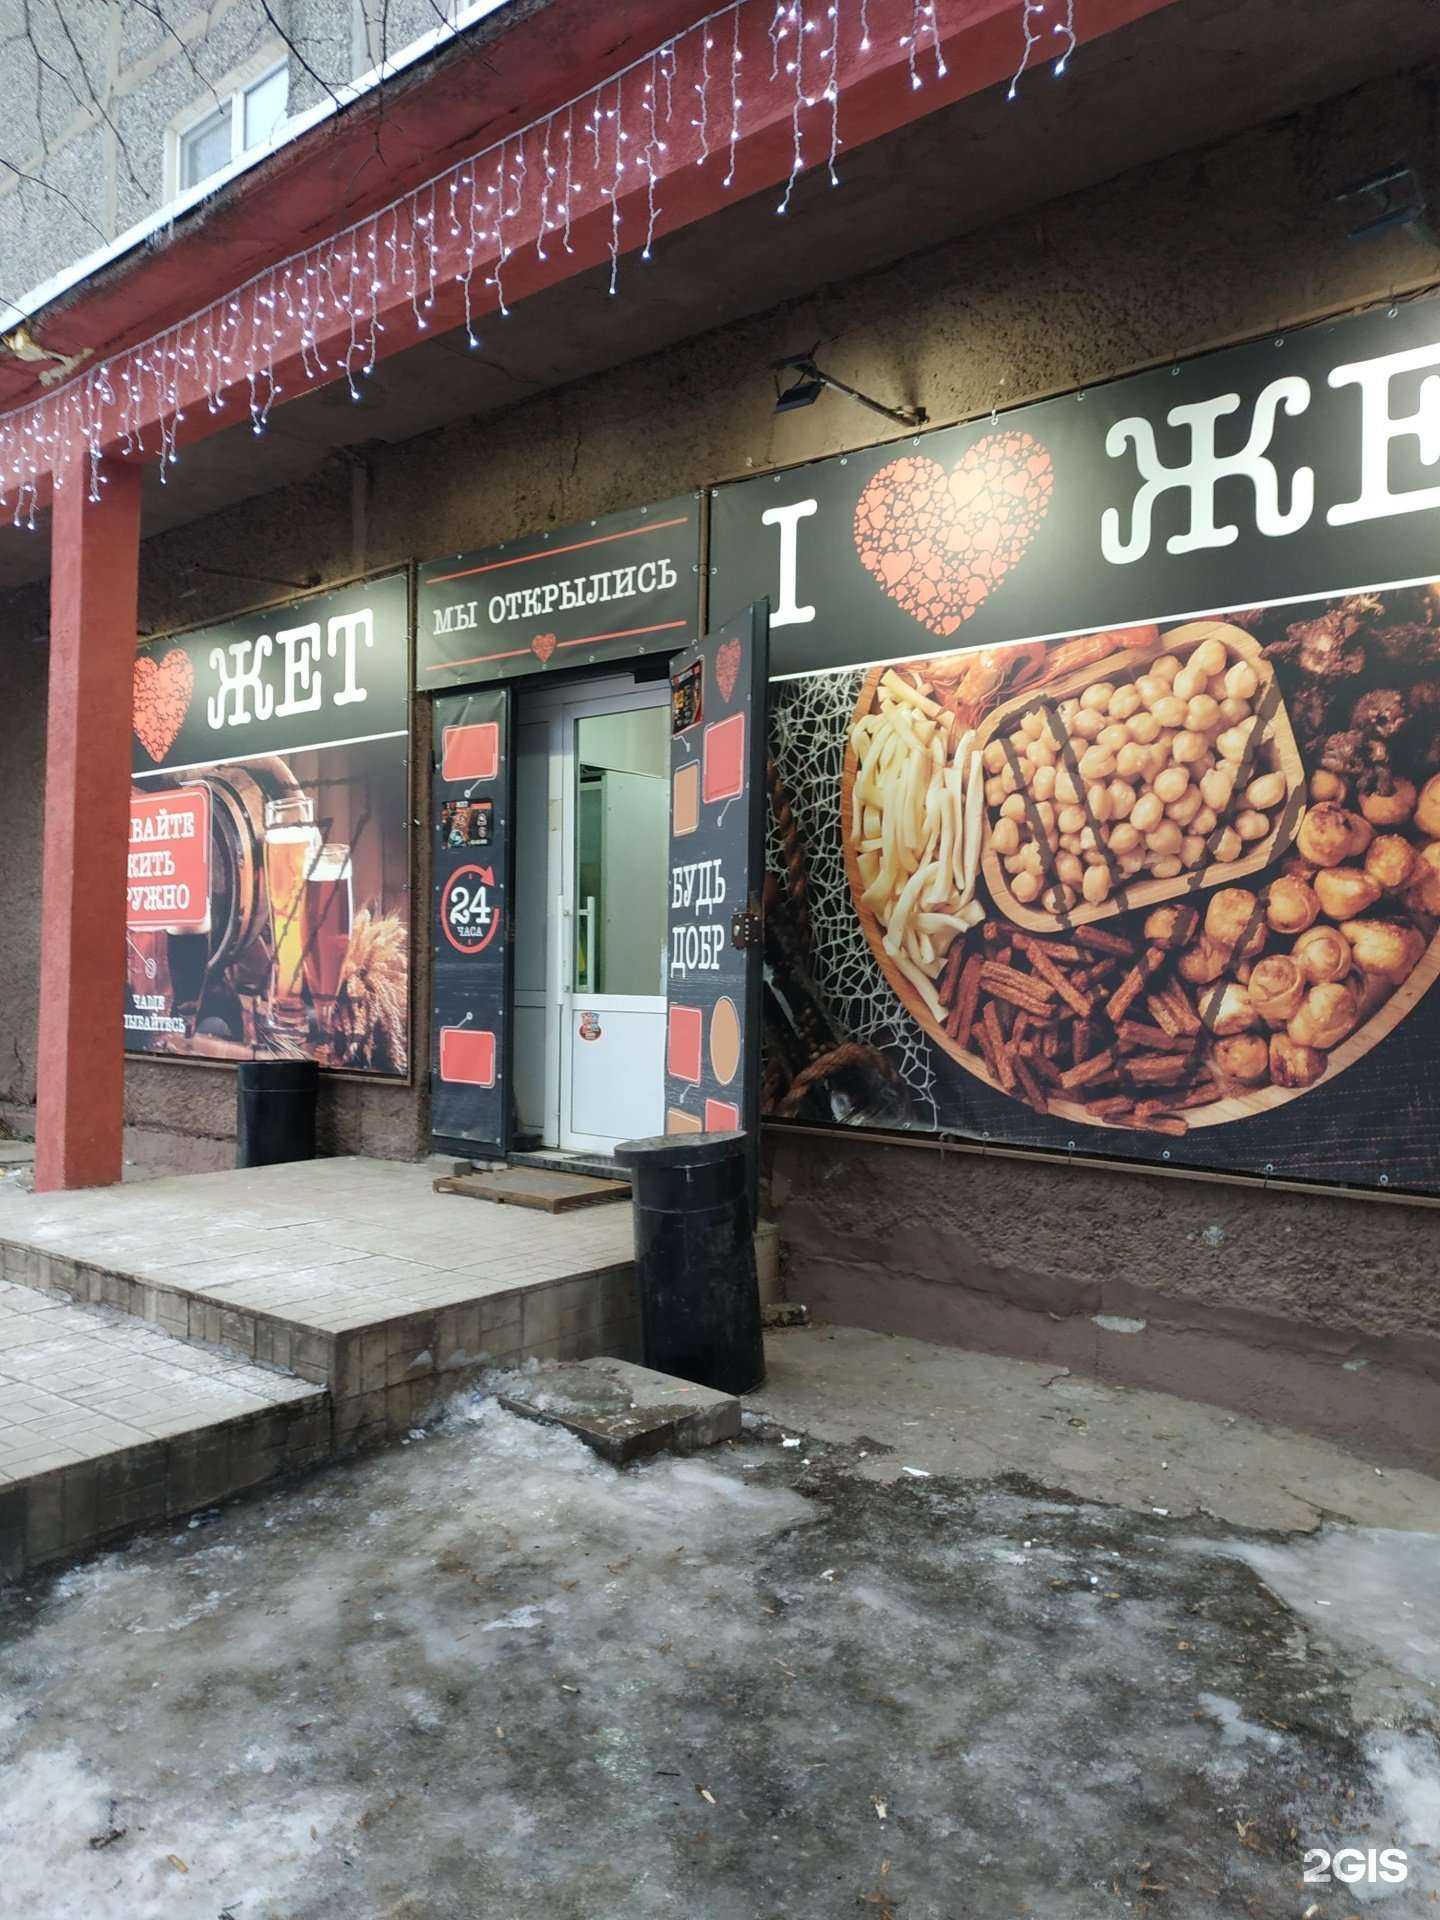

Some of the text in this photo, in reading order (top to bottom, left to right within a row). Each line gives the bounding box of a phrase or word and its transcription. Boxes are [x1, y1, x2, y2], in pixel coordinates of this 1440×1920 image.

[1101, 343, 1440, 565] ЖЕ
[433, 559, 678, 635] МЫ ОТКРЫЛИСЬ
[207, 608, 374, 730] ЖЕТ
[128, 808, 195, 843] ВАЙТЕ
[450, 886, 491, 925] 24
[671, 858, 726, 916] БУДЬ
[457, 926, 483, 937] ЧАСА
[671, 924, 725, 978] ДОБР
